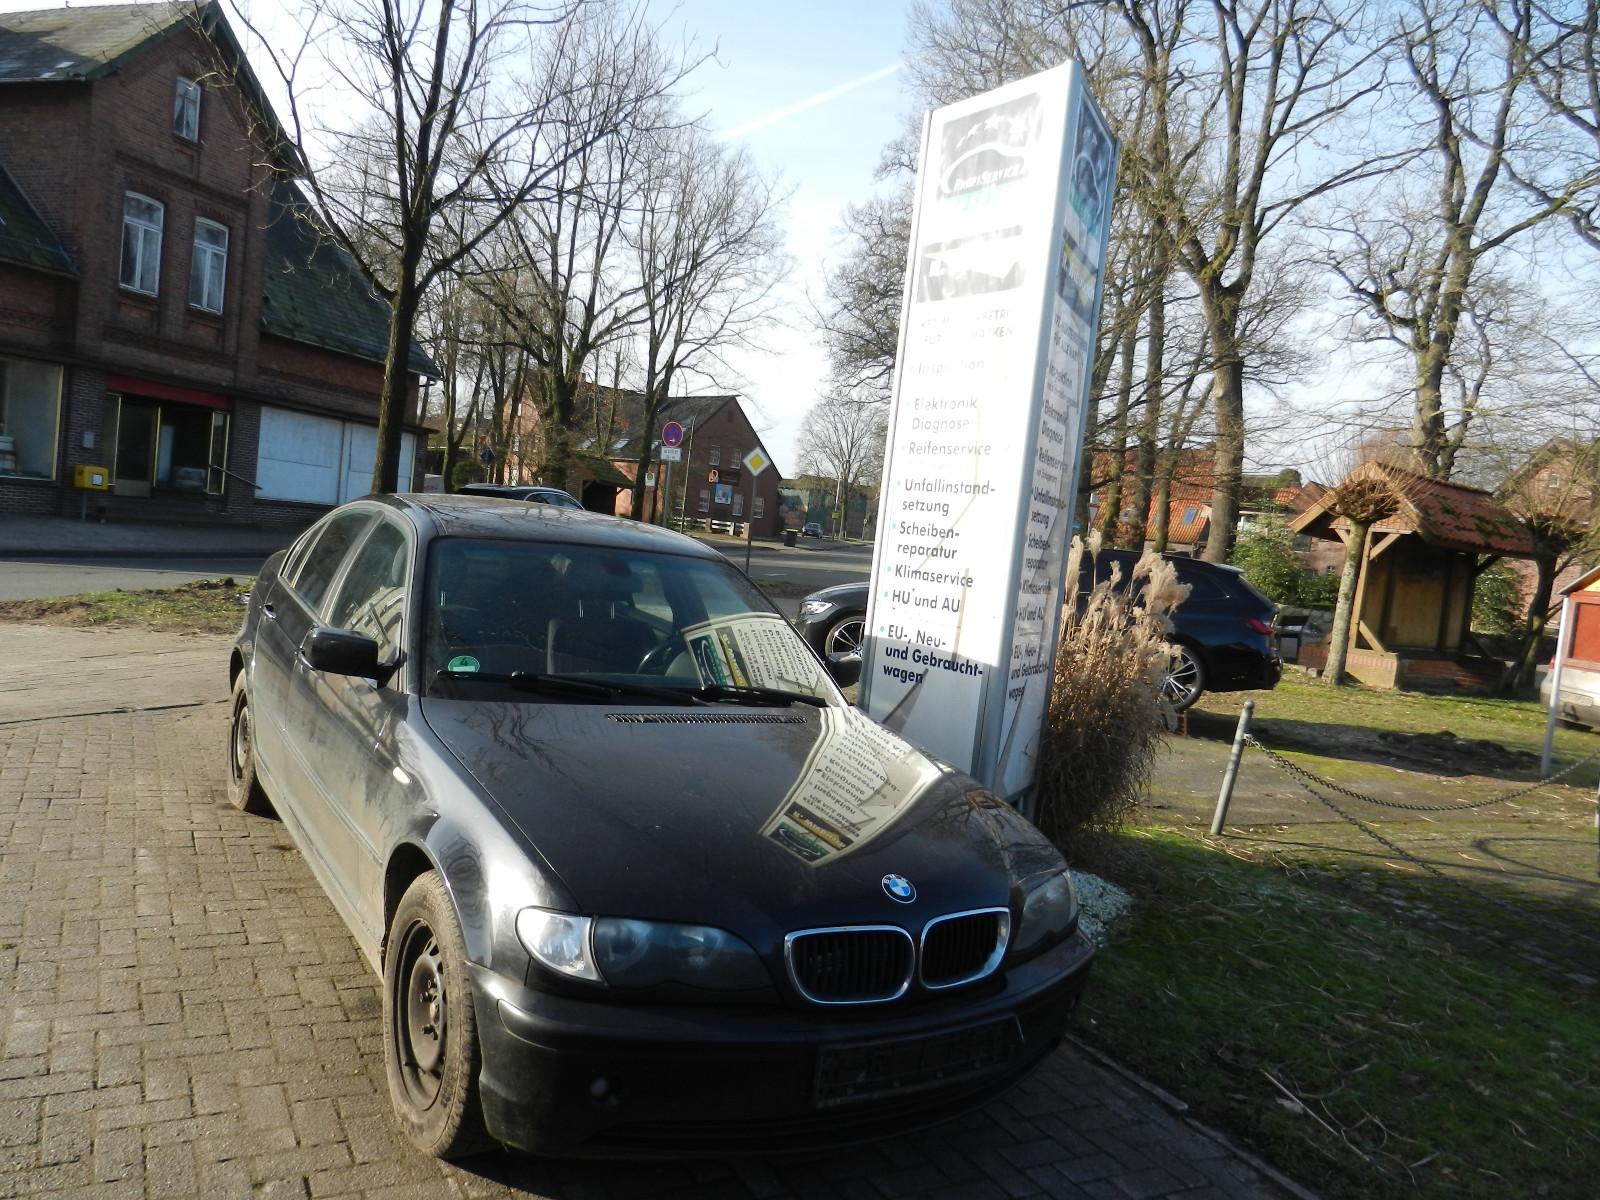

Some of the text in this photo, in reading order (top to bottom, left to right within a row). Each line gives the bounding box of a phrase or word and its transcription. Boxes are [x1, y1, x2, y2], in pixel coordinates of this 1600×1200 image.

[914, 397, 978, 411] Elektronik
[911, 417, 970, 434] Diagnose
[908, 442, 992, 456] Reifenservice
[905, 478, 996, 495] Unfallinstand-
[902, 499, 950, 516] setzung
[899, 521, 960, 539] Scheiben-
[897, 543, 958, 559] reparatur
[892, 589, 961, 613] HU und AU
[887, 624, 947, 648] EU-, Neu-
[885, 645, 983, 677] und Gebraucht-
[883, 663, 924, 684] wagen
